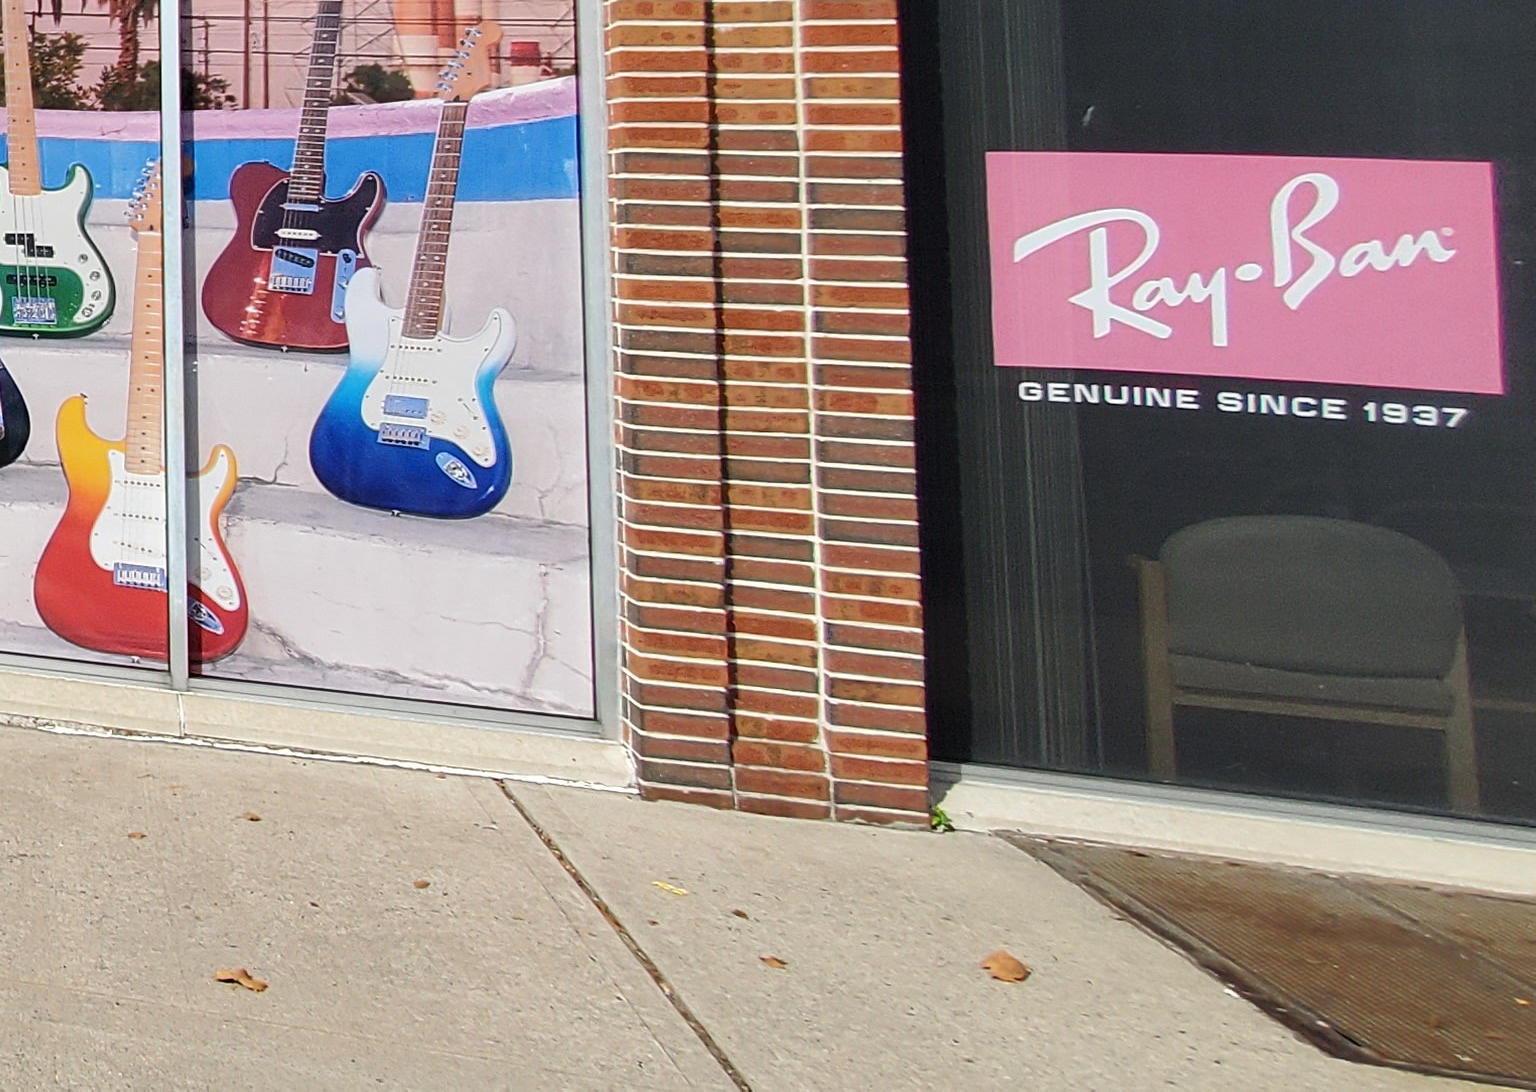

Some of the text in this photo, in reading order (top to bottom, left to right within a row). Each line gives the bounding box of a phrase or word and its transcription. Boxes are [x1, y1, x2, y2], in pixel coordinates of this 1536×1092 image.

[1017, 380, 1469, 429] GENUINE SINCE 1937
